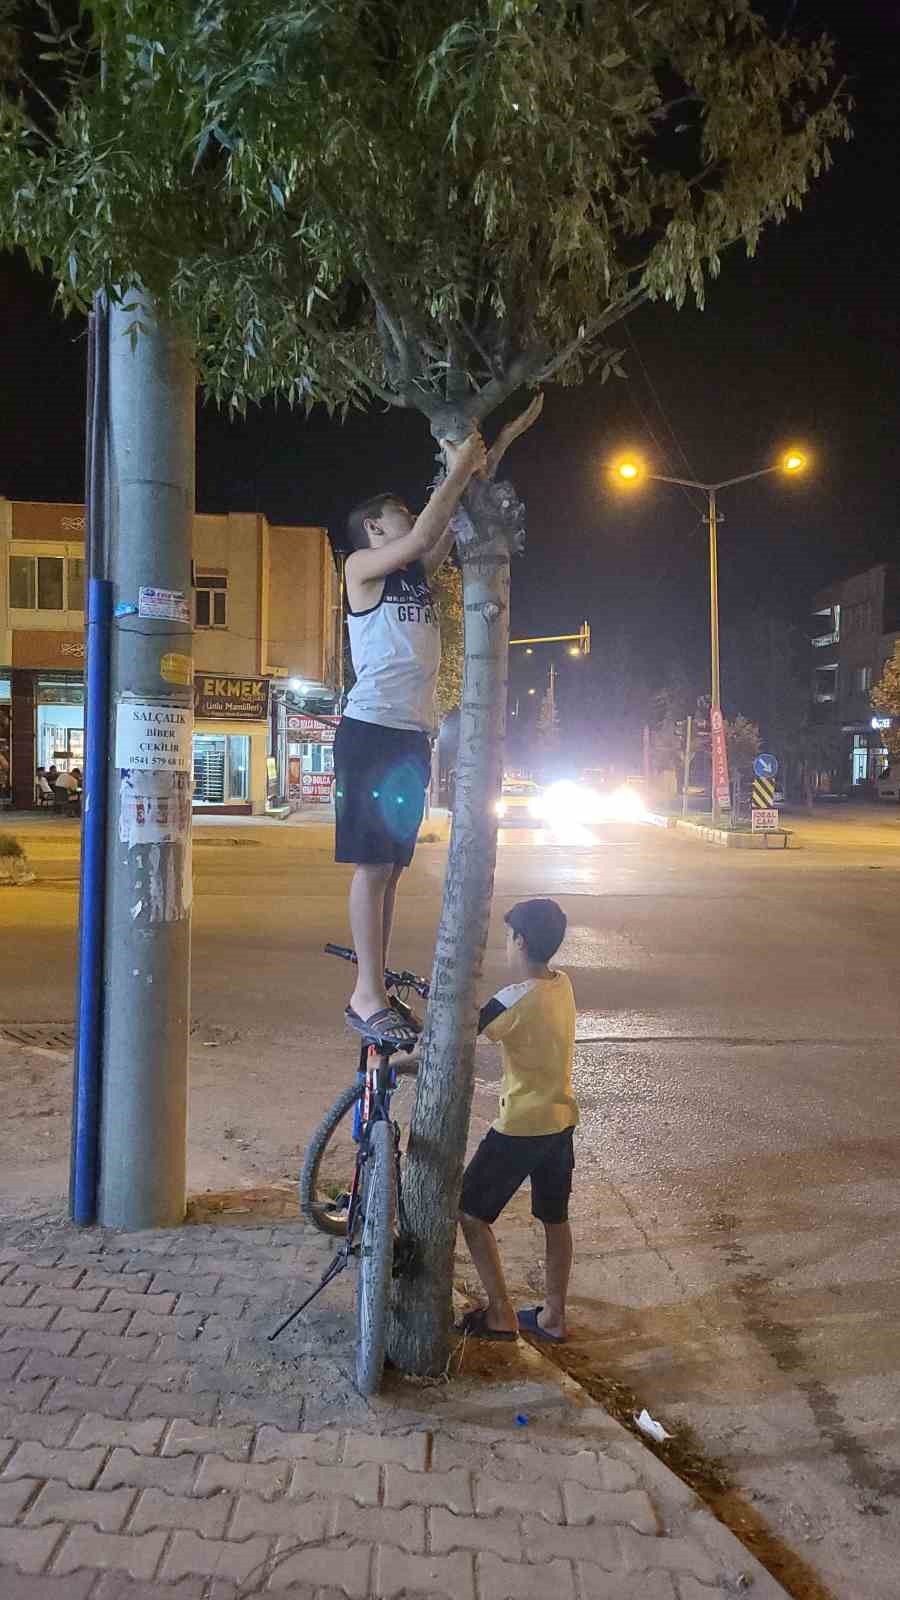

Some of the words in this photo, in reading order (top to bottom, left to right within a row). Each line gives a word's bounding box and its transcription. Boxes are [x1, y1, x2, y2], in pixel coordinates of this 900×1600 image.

[398, 606, 421, 624] GET
[204, 679, 263, 697] EKMEK
[132, 711, 186, 724] SALÇALIK
[145, 727, 176, 738] BİBER
[139, 741, 179, 753] ÇEKİLİR
[151, 756, 166, 766] 579
[312, 775, 331, 785] DOLCA
